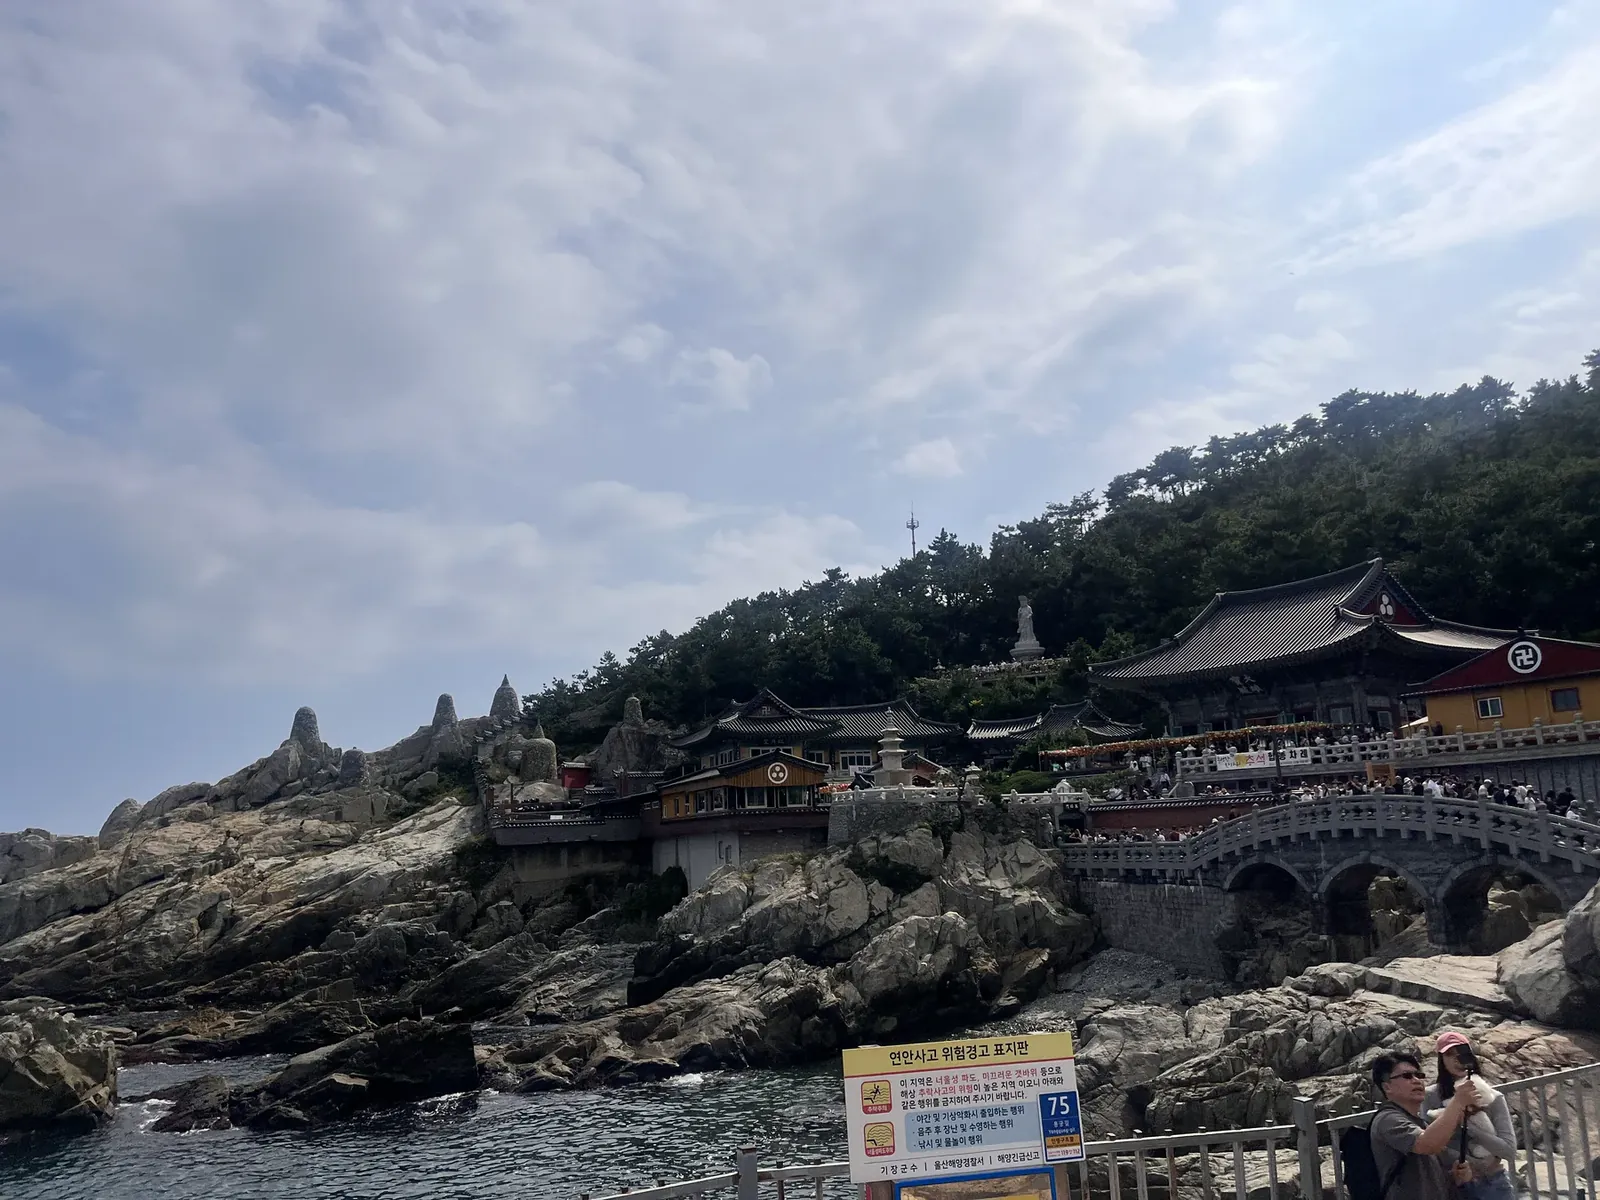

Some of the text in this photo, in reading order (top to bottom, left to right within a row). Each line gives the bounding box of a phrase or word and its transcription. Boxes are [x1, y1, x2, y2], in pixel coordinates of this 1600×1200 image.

[889, 1041, 1029, 1067] 연안사고 위험경고 표지판
[900, 1080, 908, 1088] 이
[910, 1077, 933, 1087] 지역은
[935, 1074, 959, 1085] 너울성
[982, 1070, 1013, 1080] 미끄러운
[1014, 1067, 1038, 1077] 갯바위
[1040, 1066, 1062, 1077] 등으로
[900, 1076, 1064, 1099] 해상 추락사고의 위험이 높은 지역 이오니 아래와
[901, 1090, 1028, 1111] 같은 행위를 금지하여 주시기 바랍니다.
[1047, 1095, 1070, 1116] 75
[916, 1104, 1025, 1124] 야간 및 기상악화시 출입하는 행위
[917, 1118, 1014, 1137] 음주 후 장난 및 수영하는 행위
[918, 1134, 983, 1150] 낚시 및 물놀이 행위
[934, 1156, 985, 1171] 울산해양경찰서
[997, 1151, 1041, 1164] 해양긴급신고
